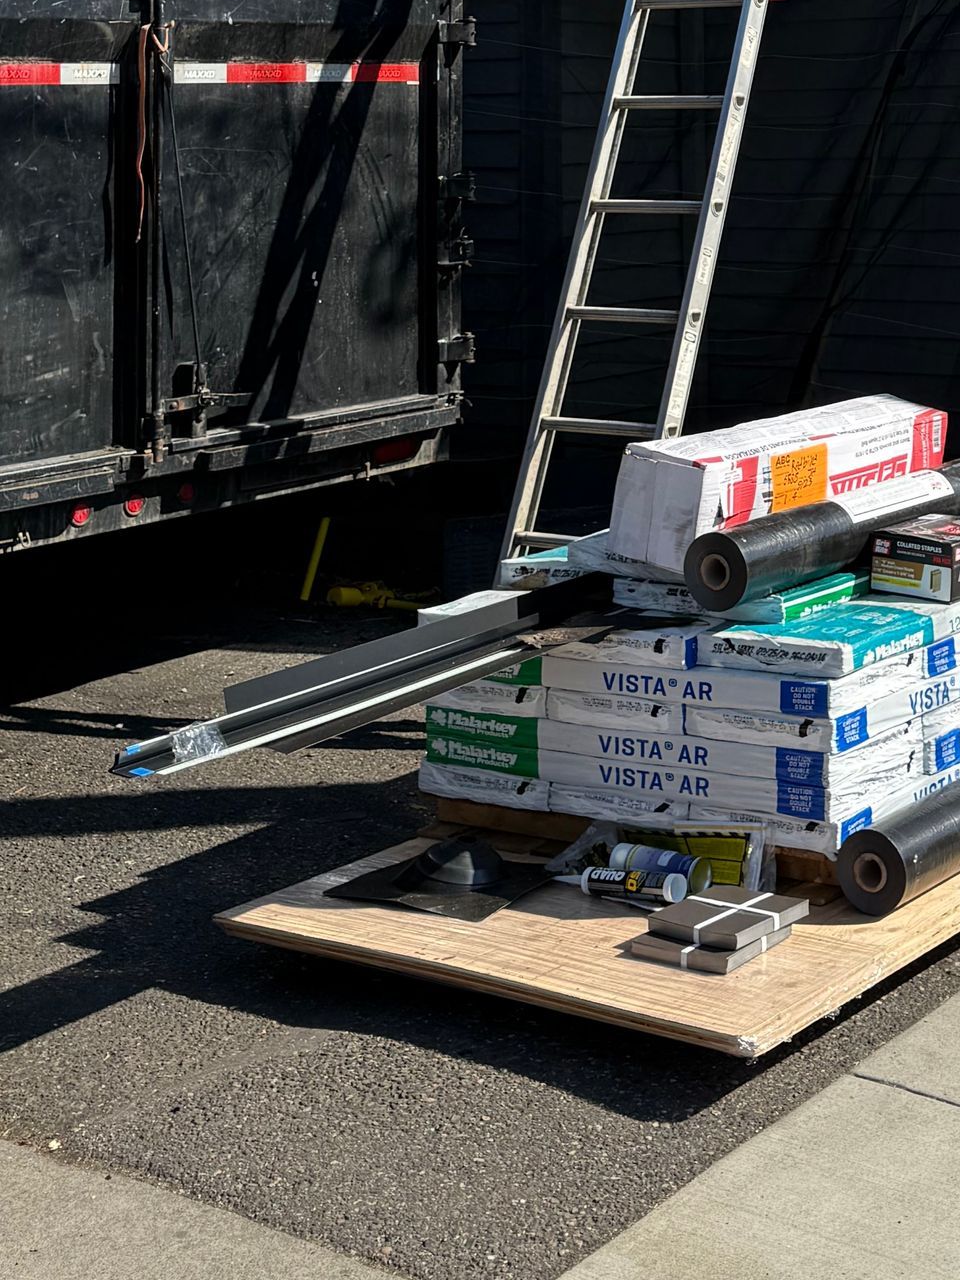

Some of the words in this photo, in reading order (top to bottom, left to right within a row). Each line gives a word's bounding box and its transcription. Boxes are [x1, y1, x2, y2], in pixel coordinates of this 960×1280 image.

[184, 70, 215, 79] MAXXD
[896, 540, 921, 551] COLLATED
[921, 544, 943, 554] STAPLES
[875, 629, 925, 661] Malarkey
[682, 680, 713, 701] AR
[792, 698, 816, 706] DOUBLE
[794, 703, 814, 712] STACK
[448, 711, 518, 736] Malarkey
[448, 739, 518, 766] Malarkey
[678, 744, 709, 767] AR
[679, 774, 710, 798] AR
[590, 869, 626, 882] QUAD
